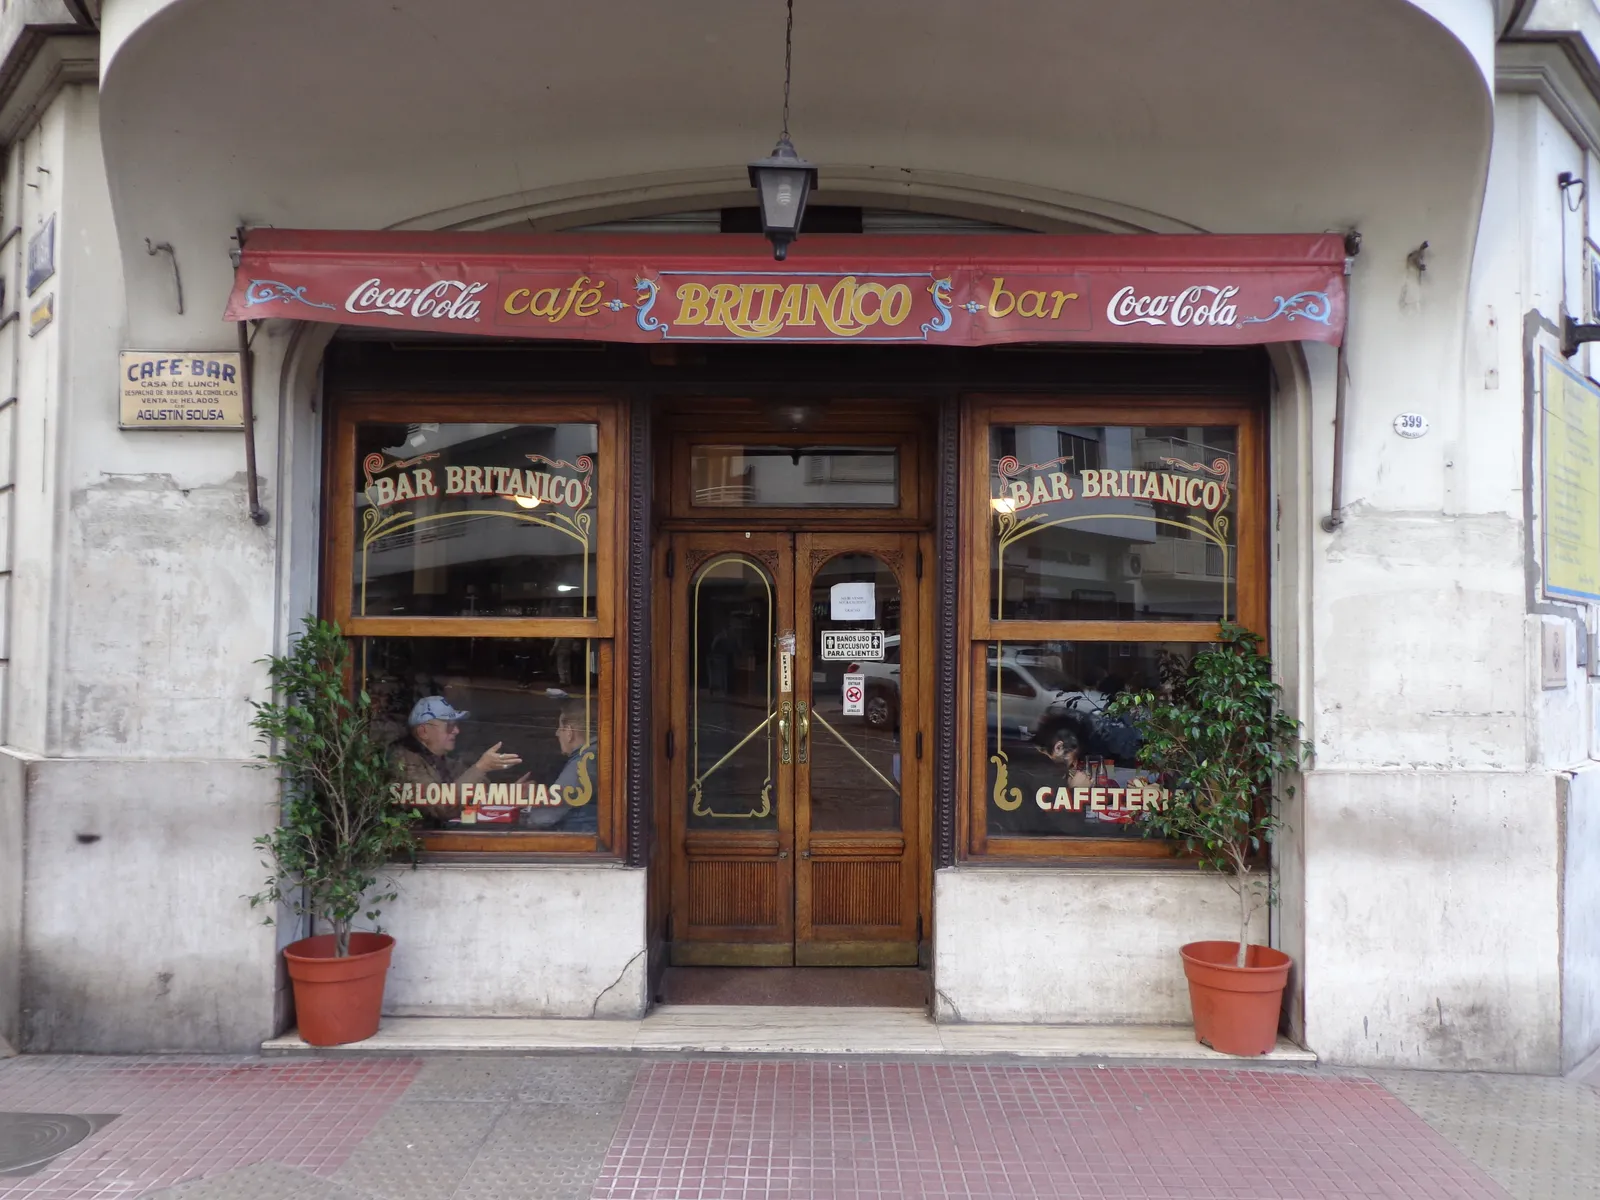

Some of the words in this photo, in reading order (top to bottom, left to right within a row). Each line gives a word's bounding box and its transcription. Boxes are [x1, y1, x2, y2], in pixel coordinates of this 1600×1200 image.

[345, 278, 488, 320] Coca-Cola
[504, 276, 605, 323] café
[673, 276, 912, 338] BRITANICO
[988, 277, 1078, 320] bar
[1107, 285, 1240, 326] Coca-Cola
[137, 410, 184, 421] AGUSTIN
[186, 410, 225, 421] SOUSA
[1402, 415, 1422, 428] 399
[375, 468, 438, 507] BAR
[445, 466, 584, 508] BRITANICO
[1009, 472, 1074, 510] BAR
[1080, 469, 1222, 511] BRITANICO
[389, 782, 457, 806] SALON
[460, 783, 563, 806] FAMILIAS
